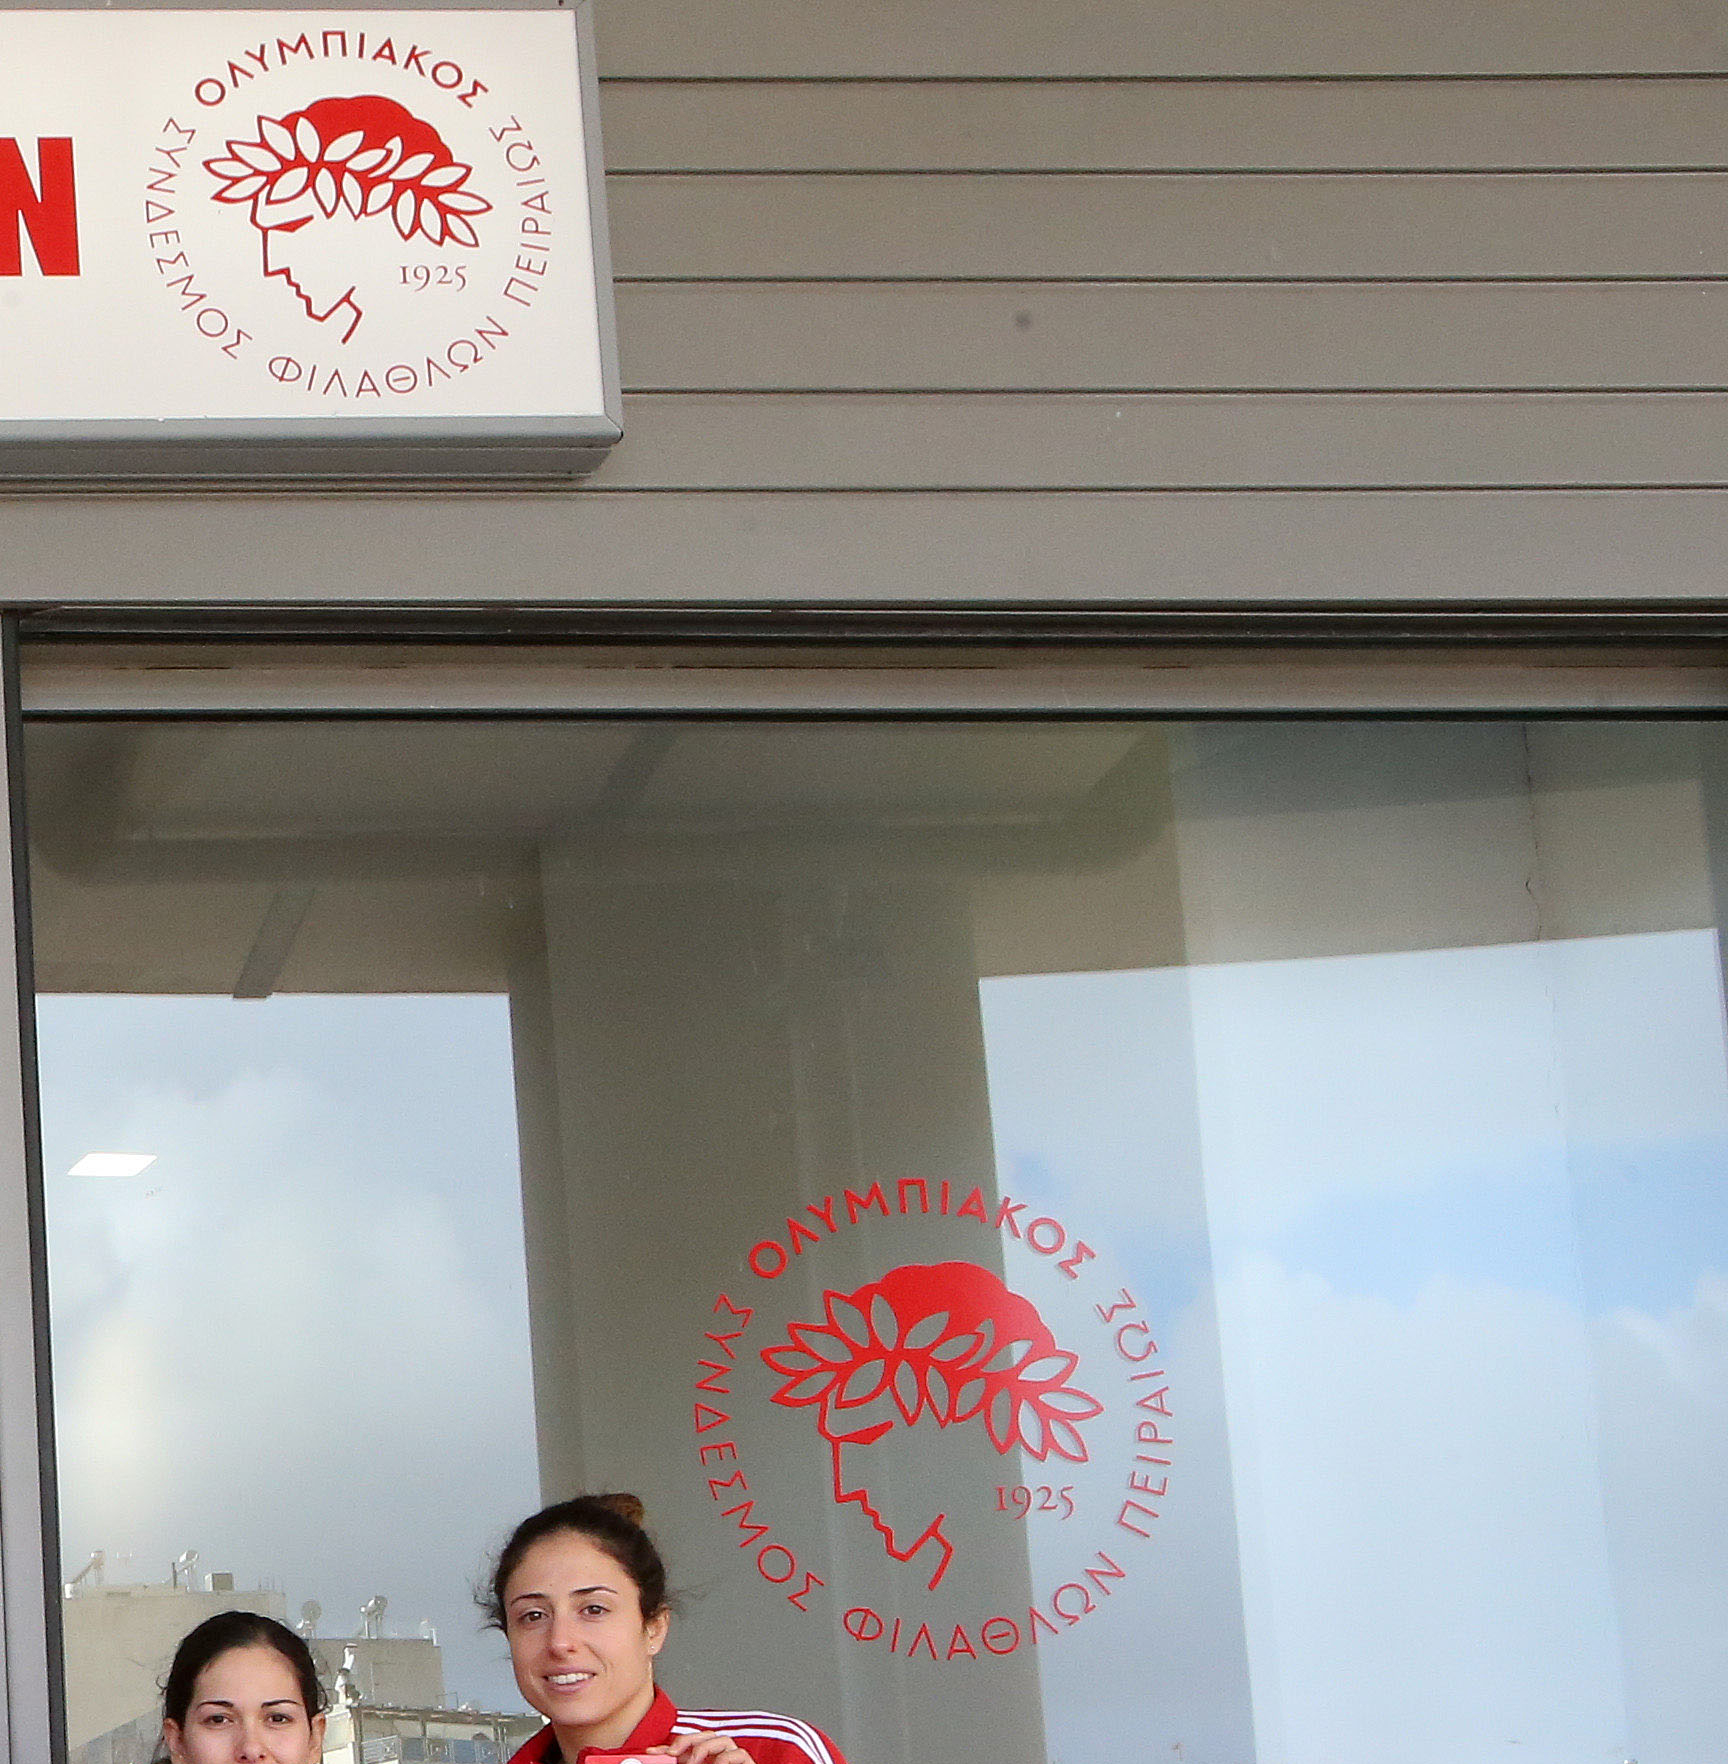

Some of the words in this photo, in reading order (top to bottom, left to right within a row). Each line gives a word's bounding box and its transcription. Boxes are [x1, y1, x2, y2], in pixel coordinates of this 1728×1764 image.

[196, 30, 490, 107] ΟΛΥΜΠΙΑΚΟΣ
[398, 262, 469, 294] 1925
[748, 1178, 1096, 1280] ΟΛΥΜΠΙΑΚΟΣ
[695, 1294, 825, 1611] ΣΥΝΔΕΣΜΟΣ
[844, 1551, 1126, 1660] ΦΙΛΑΘΛΩΝ
[1096, 1288, 1174, 1538] ΠΕΙΡΑΙΩΣ
[994, 1485, 1077, 1520] 1925
